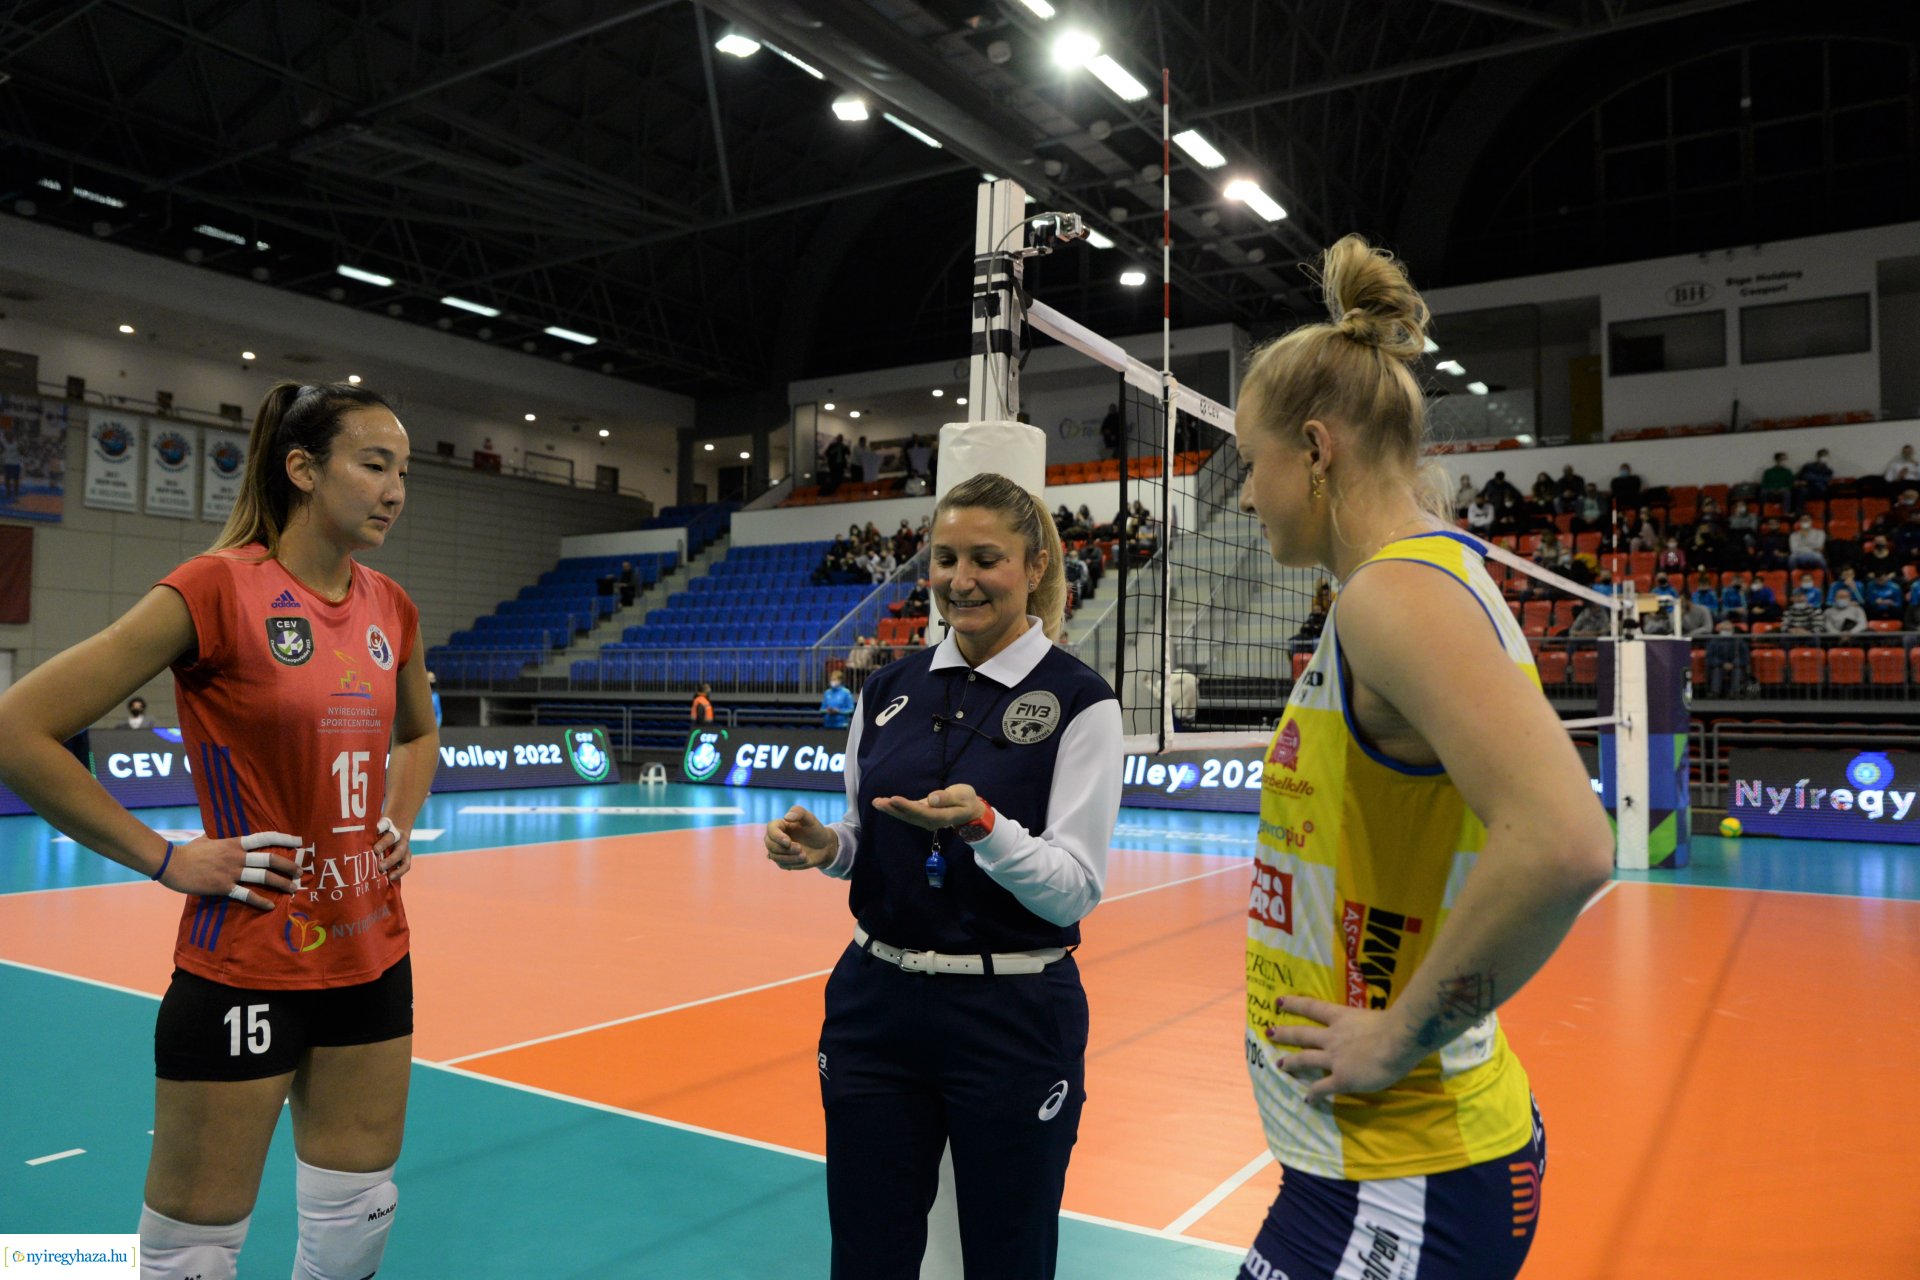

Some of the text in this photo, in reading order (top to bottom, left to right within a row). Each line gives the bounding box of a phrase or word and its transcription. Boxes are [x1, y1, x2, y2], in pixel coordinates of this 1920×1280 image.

[1675, 286, 1705, 303] BH
[276, 620, 297, 628] CEV
[321, 718, 381, 727] SPORTCENTRUM
[1016, 702, 1051, 718] FIVB
[108, 753, 172, 778] CEV
[439, 745, 508, 770] Volley
[513, 744, 563, 765] 2022
[736, 743, 789, 770] CEV
[331, 751, 370, 819] 15
[223, 1003, 271, 1057] 15
